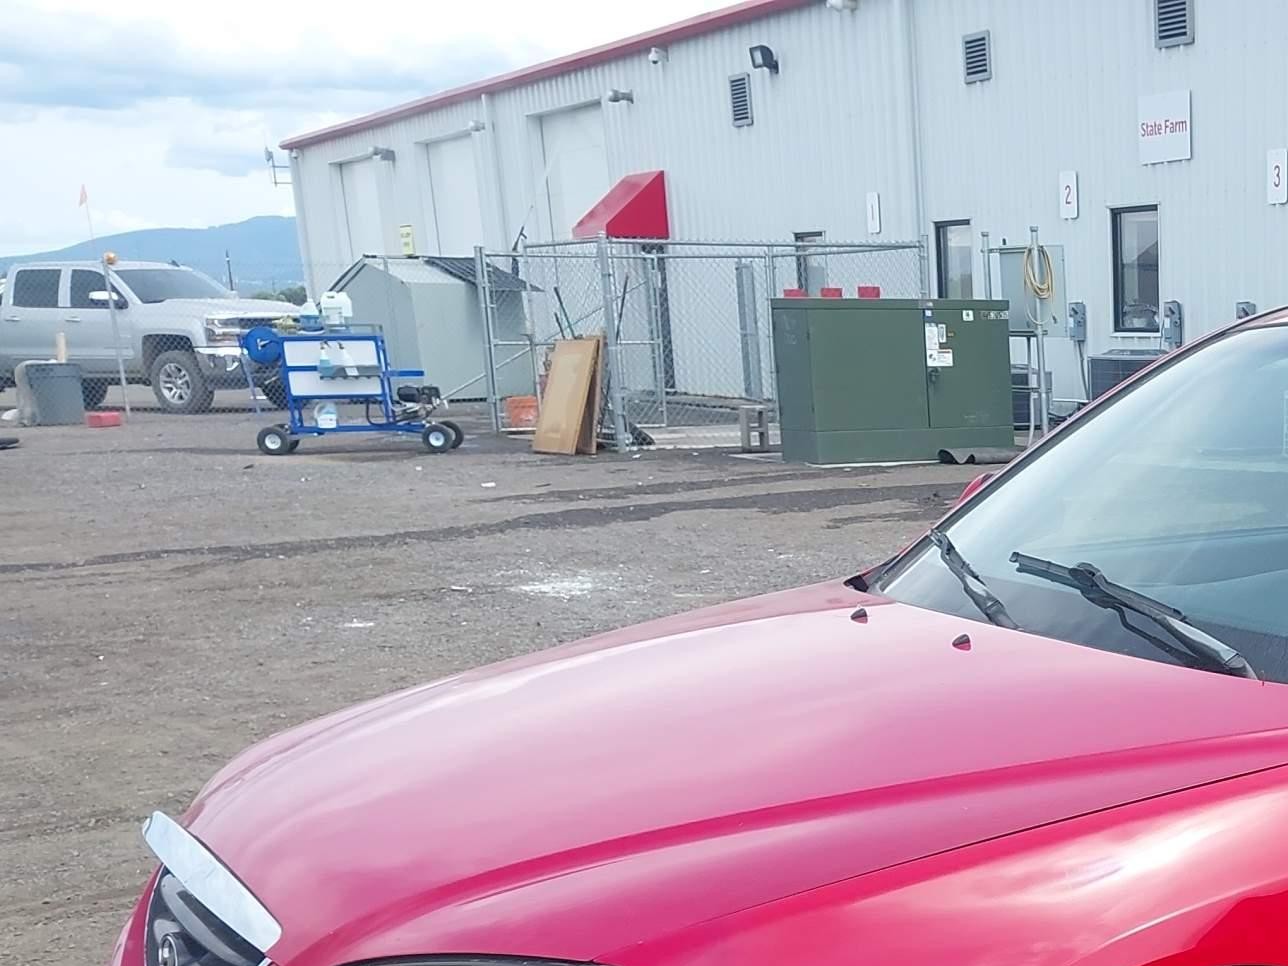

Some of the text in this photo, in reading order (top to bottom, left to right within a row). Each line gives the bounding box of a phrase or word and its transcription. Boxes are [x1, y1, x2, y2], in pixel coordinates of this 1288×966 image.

[1140, 118, 1188, 137] State Farm
[1273, 164, 1281, 188] 3
[1064, 184, 1072, 205] 2
